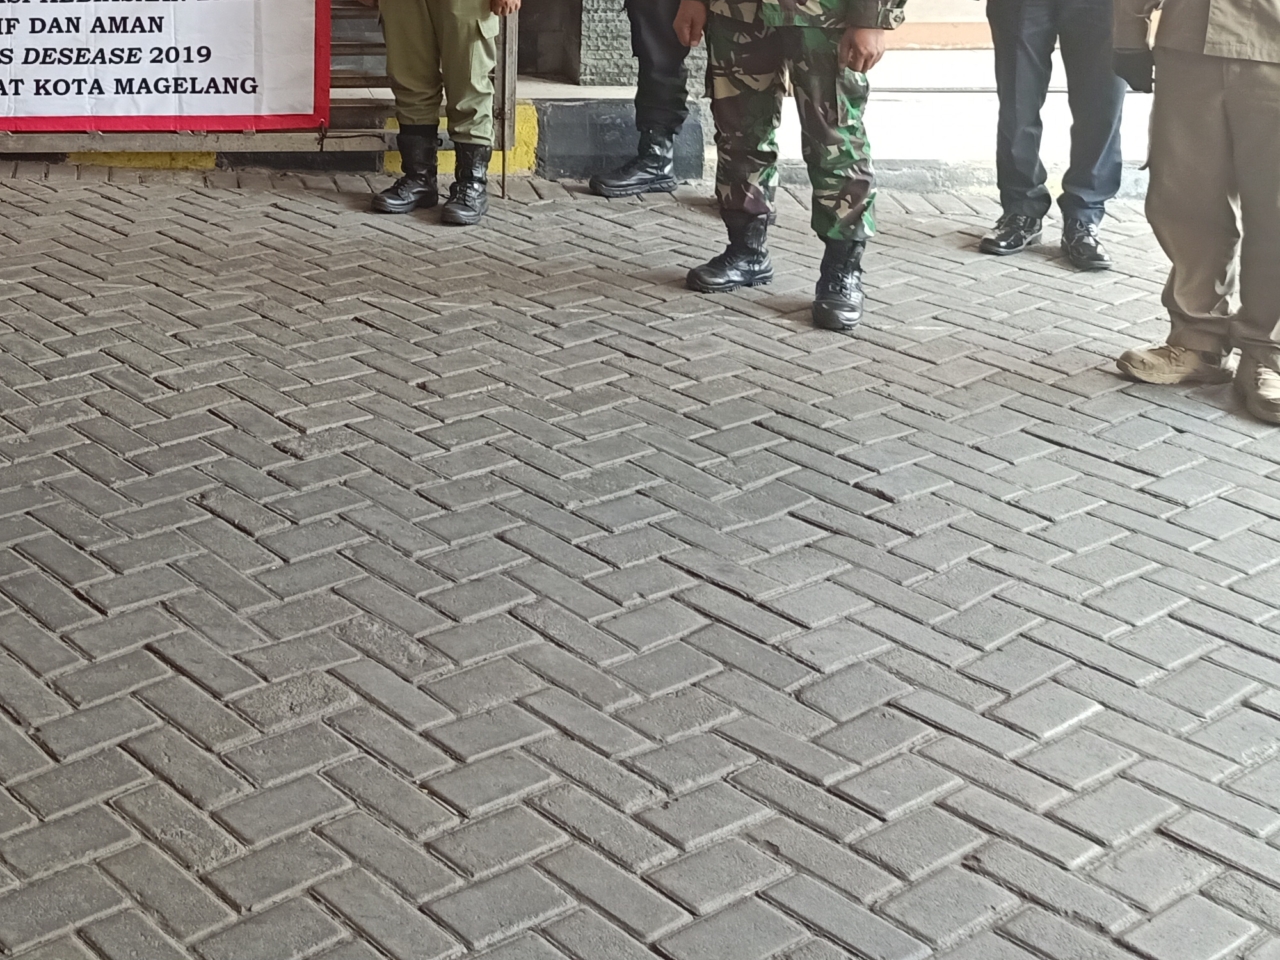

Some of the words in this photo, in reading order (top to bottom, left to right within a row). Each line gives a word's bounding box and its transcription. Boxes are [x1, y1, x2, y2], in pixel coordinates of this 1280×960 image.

[29, 16, 82, 34] DAN
[90, 16, 164, 34] AMAN
[21, 47, 142, 66] DESEASE
[149, 45, 212, 64] 2019
[33, 78, 105, 96] KOTA
[113, 76, 259, 95] MAGELANG
